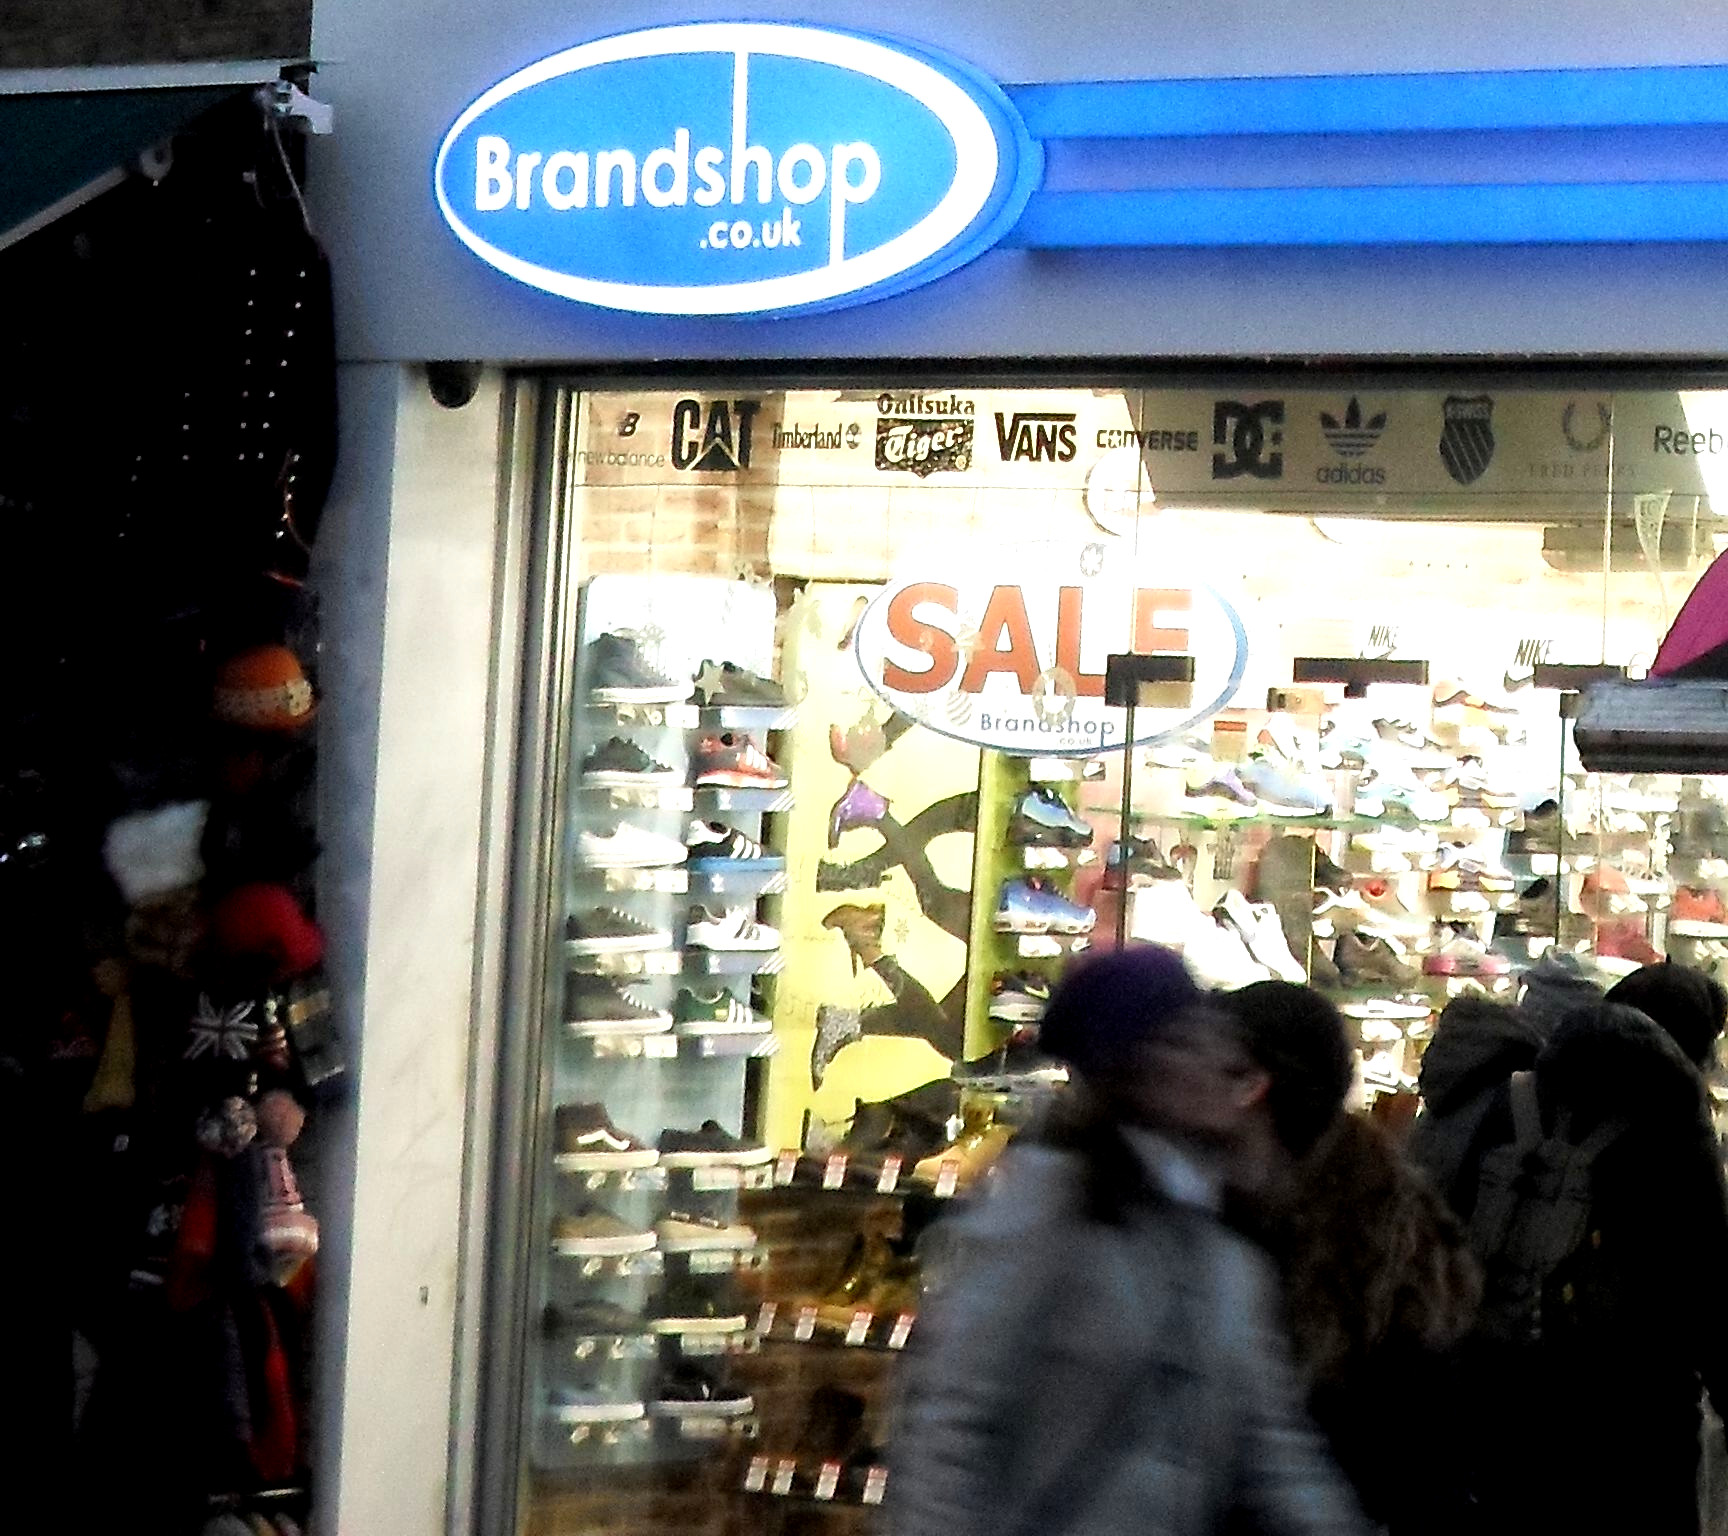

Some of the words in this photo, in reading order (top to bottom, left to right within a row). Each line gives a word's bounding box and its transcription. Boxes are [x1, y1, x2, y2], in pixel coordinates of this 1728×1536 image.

[700, 208, 802, 249] .co.uk
[876, 393, 976, 415] Onitsuka
[671, 399, 761, 471] CAT
[772, 422, 844, 450] Timberland
[884, 423, 964, 463] Tiger
[994, 412, 1077, 463] VANS
[1316, 463, 1386, 486] adidas
[1583, 463, 1636, 478] PERY
[883, 582, 1192, 697] SALE
